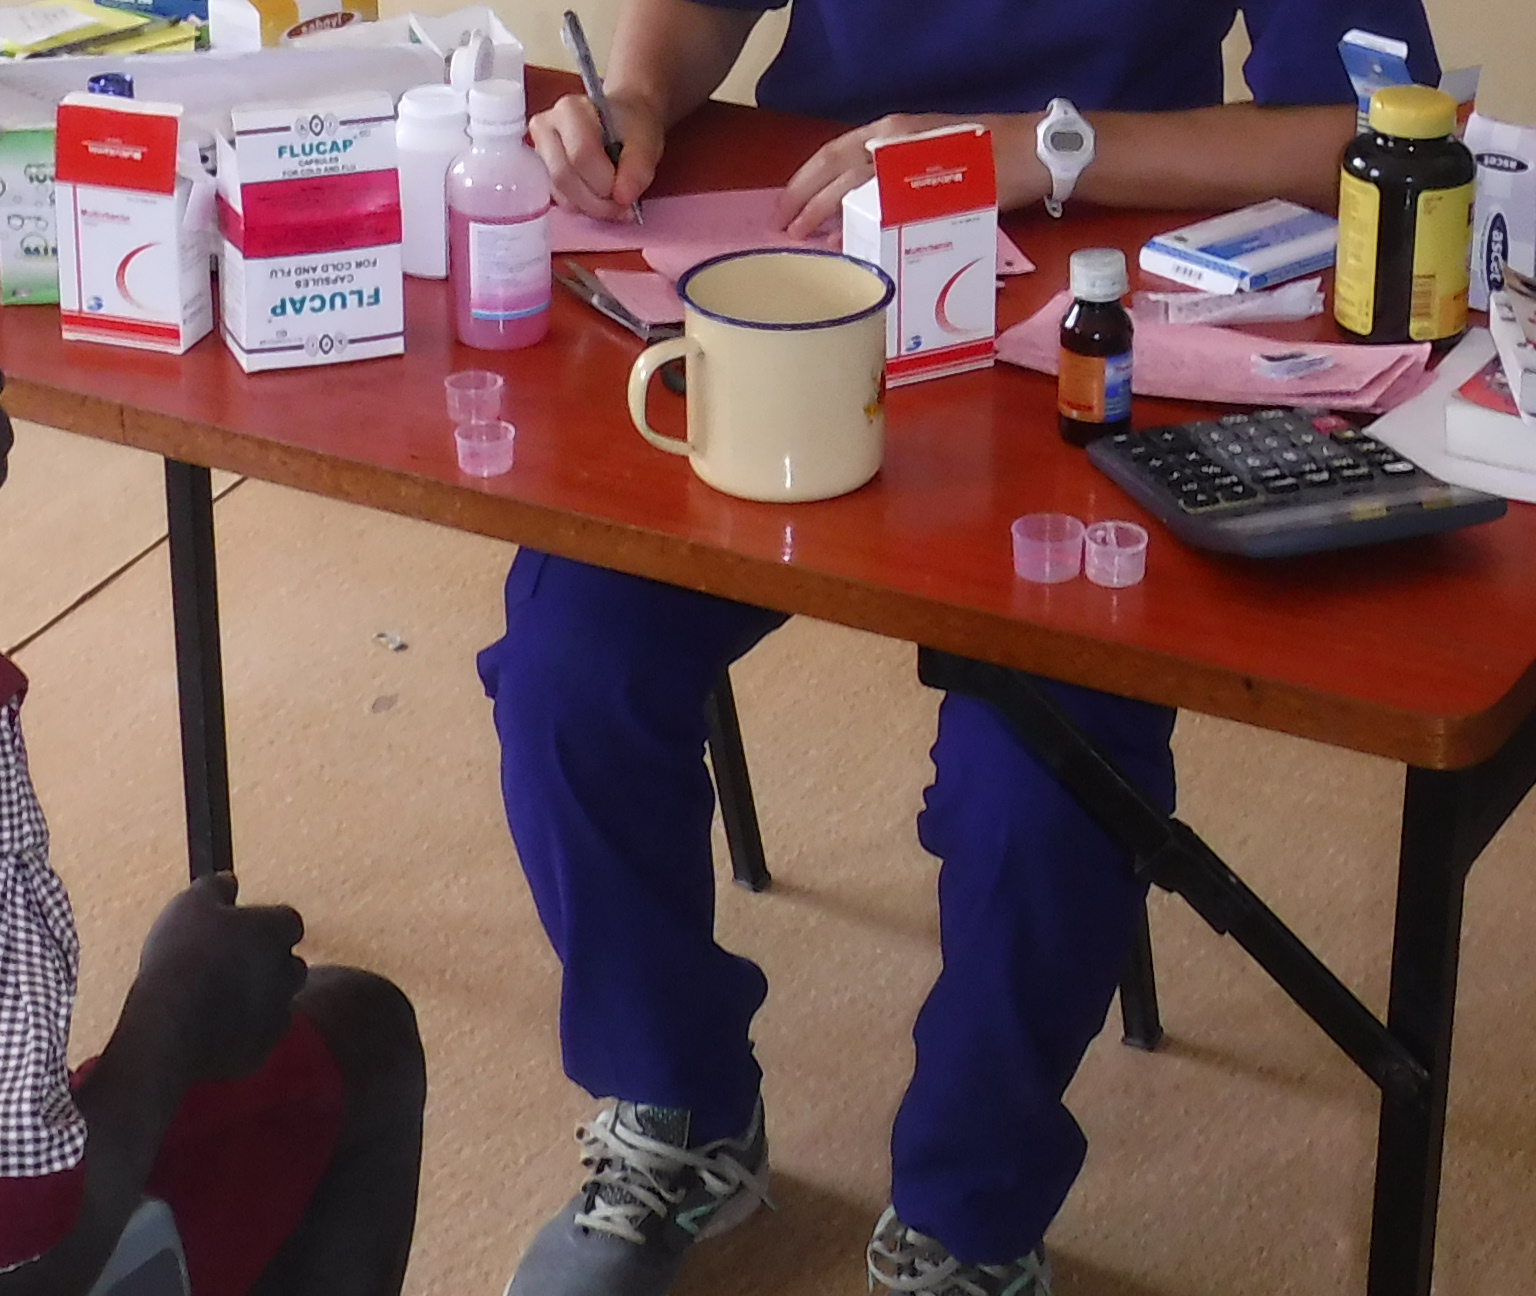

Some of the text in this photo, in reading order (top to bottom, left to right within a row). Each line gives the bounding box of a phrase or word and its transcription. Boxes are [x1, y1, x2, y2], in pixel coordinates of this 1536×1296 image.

[282, 170, 299, 178] FOR
[300, 167, 322, 177] COLD
[323, 165, 340, 174] AND
[269, 258, 378, 279] FOR COLD AND FLU
[295, 274, 354, 288] CAPSULES
[270, 287, 381, 317] FLUCAP
